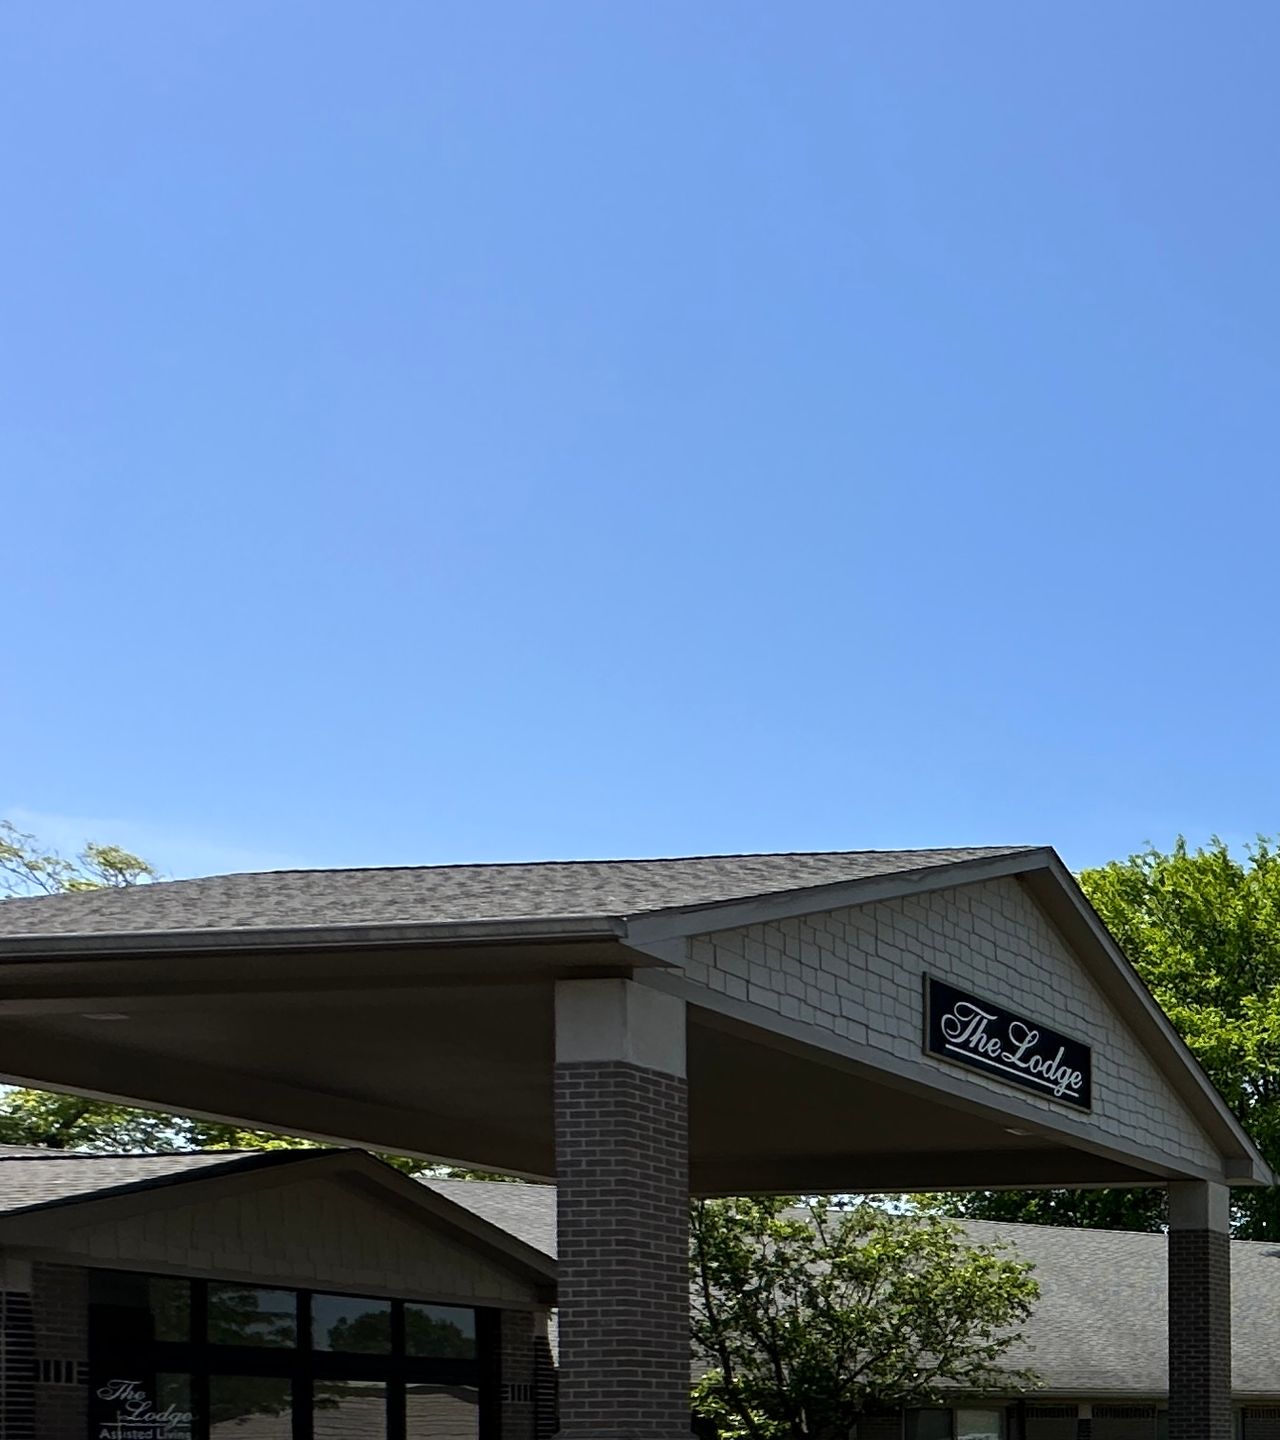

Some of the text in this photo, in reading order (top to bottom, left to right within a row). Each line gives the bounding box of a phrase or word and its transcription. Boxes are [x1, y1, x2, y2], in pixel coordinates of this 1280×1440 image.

[941, 1001, 1082, 1097] The Lodge
[96, 1379, 146, 1400] The
[119, 1400, 195, 1430] Lodge
[99, 1428, 153, 1440] Assisted
